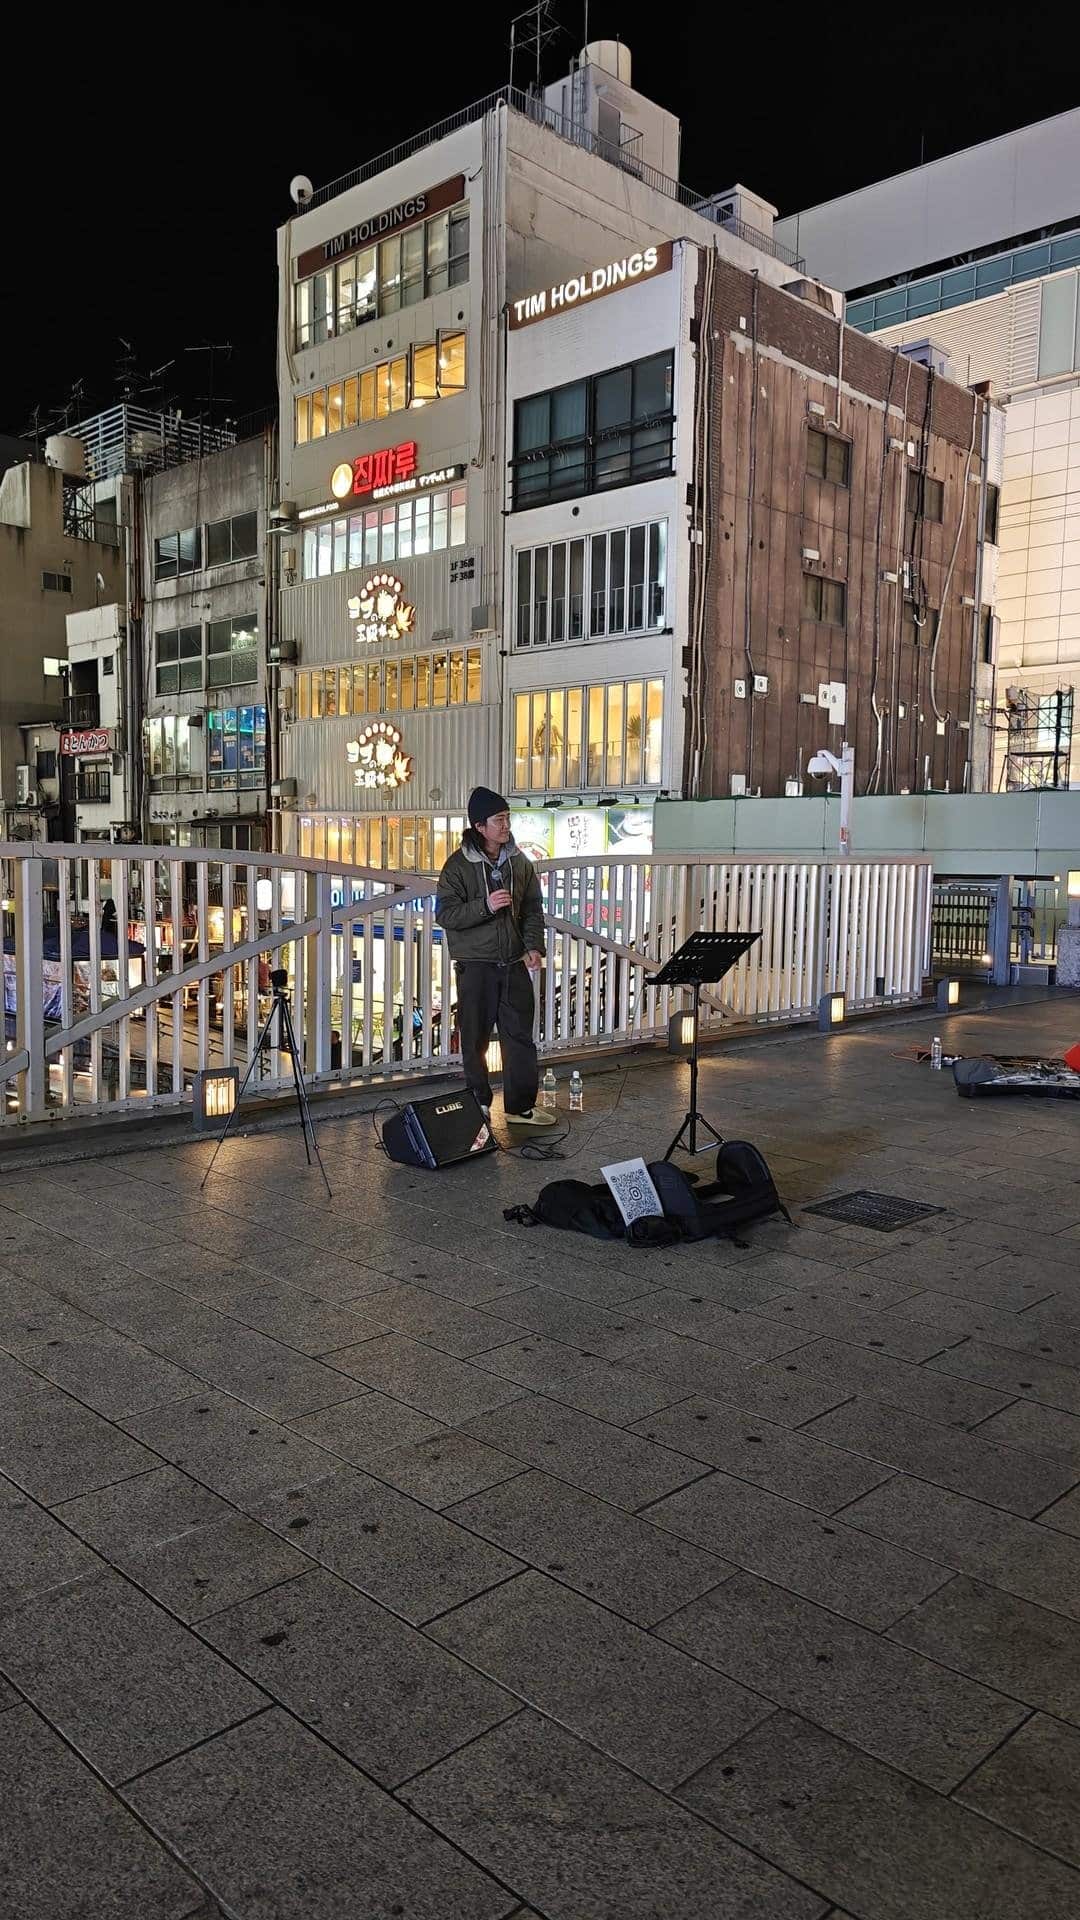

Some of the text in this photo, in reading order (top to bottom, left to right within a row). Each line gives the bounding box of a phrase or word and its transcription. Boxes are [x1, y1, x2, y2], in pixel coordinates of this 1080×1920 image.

[322, 194, 426, 260] TIM HOLDINGS
[514, 247, 658, 322] TIM HOLDINGS
[70, 733, 108, 752] とんかつ
[435, 1101, 464, 1115] CUBE
